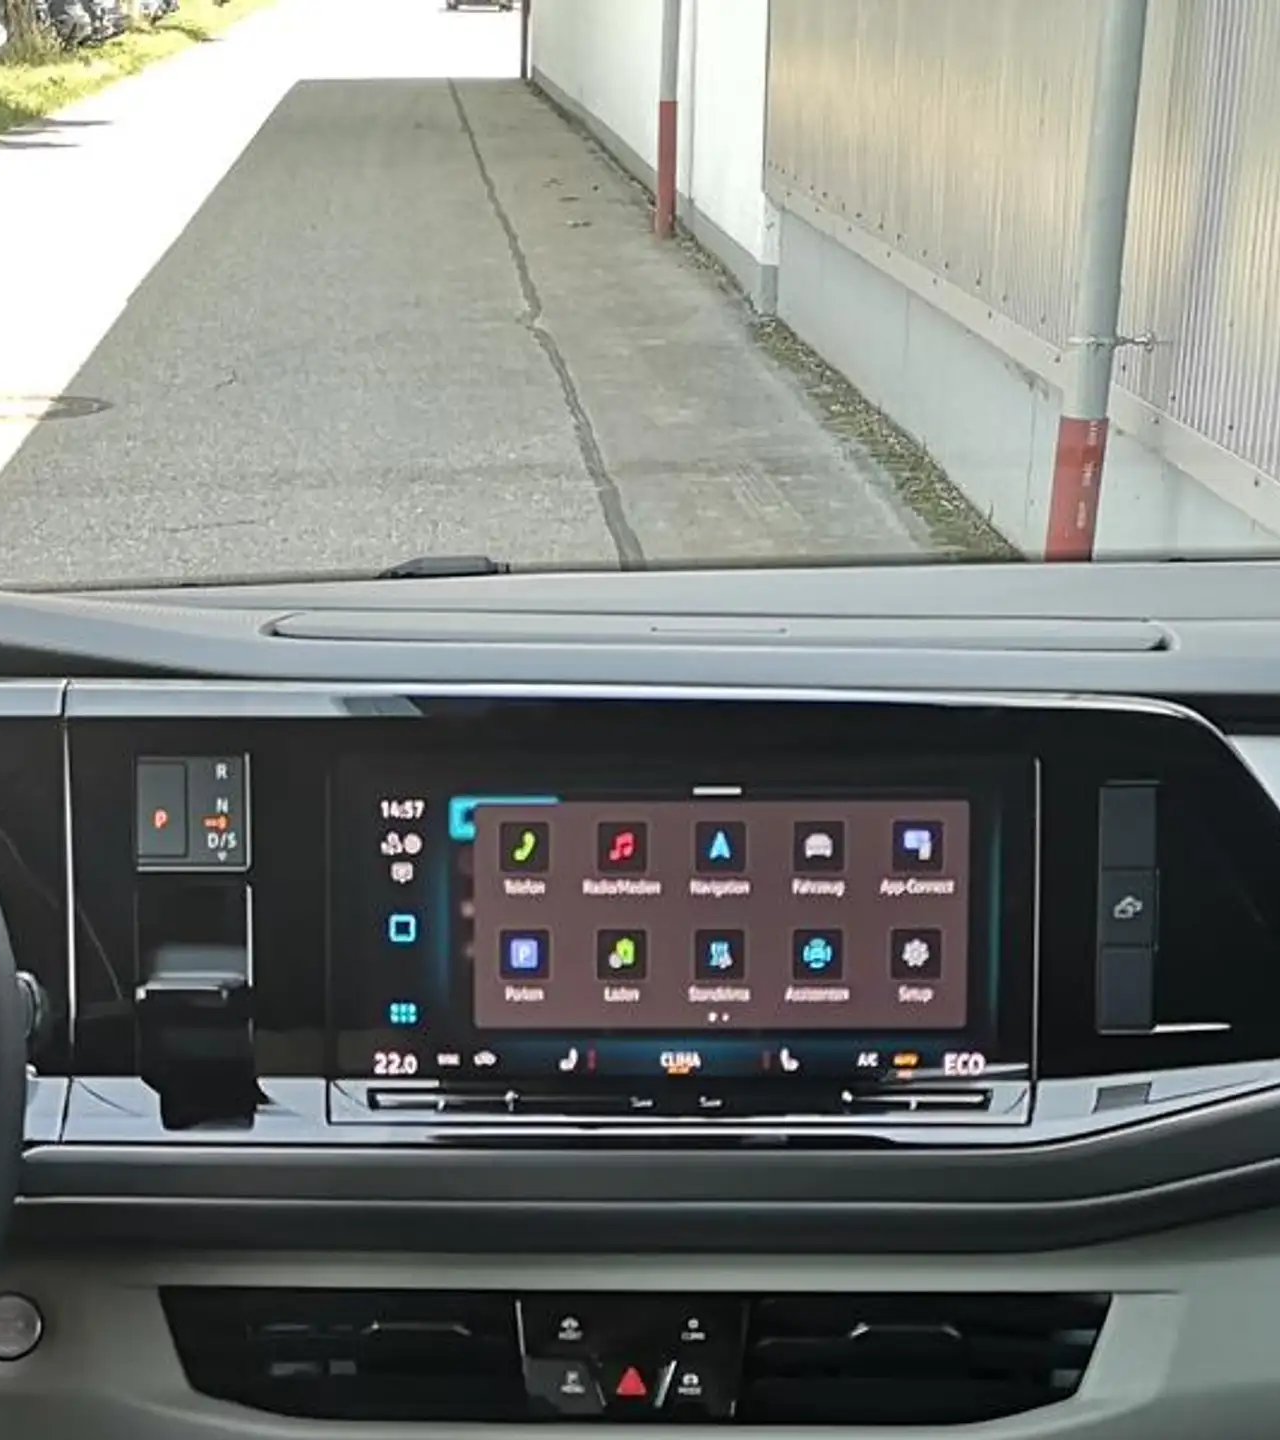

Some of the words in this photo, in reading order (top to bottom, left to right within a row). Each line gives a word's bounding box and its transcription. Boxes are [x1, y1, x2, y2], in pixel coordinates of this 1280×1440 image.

[216, 763, 228, 779] R
[216, 798, 228, 813] N
[381, 800, 424, 819] 14:57
[153, 808, 168, 829] P
[207, 832, 237, 848] D/S
[374, 1052, 418, 1075] 22.0
[944, 1052, 986, 1076] ECO
